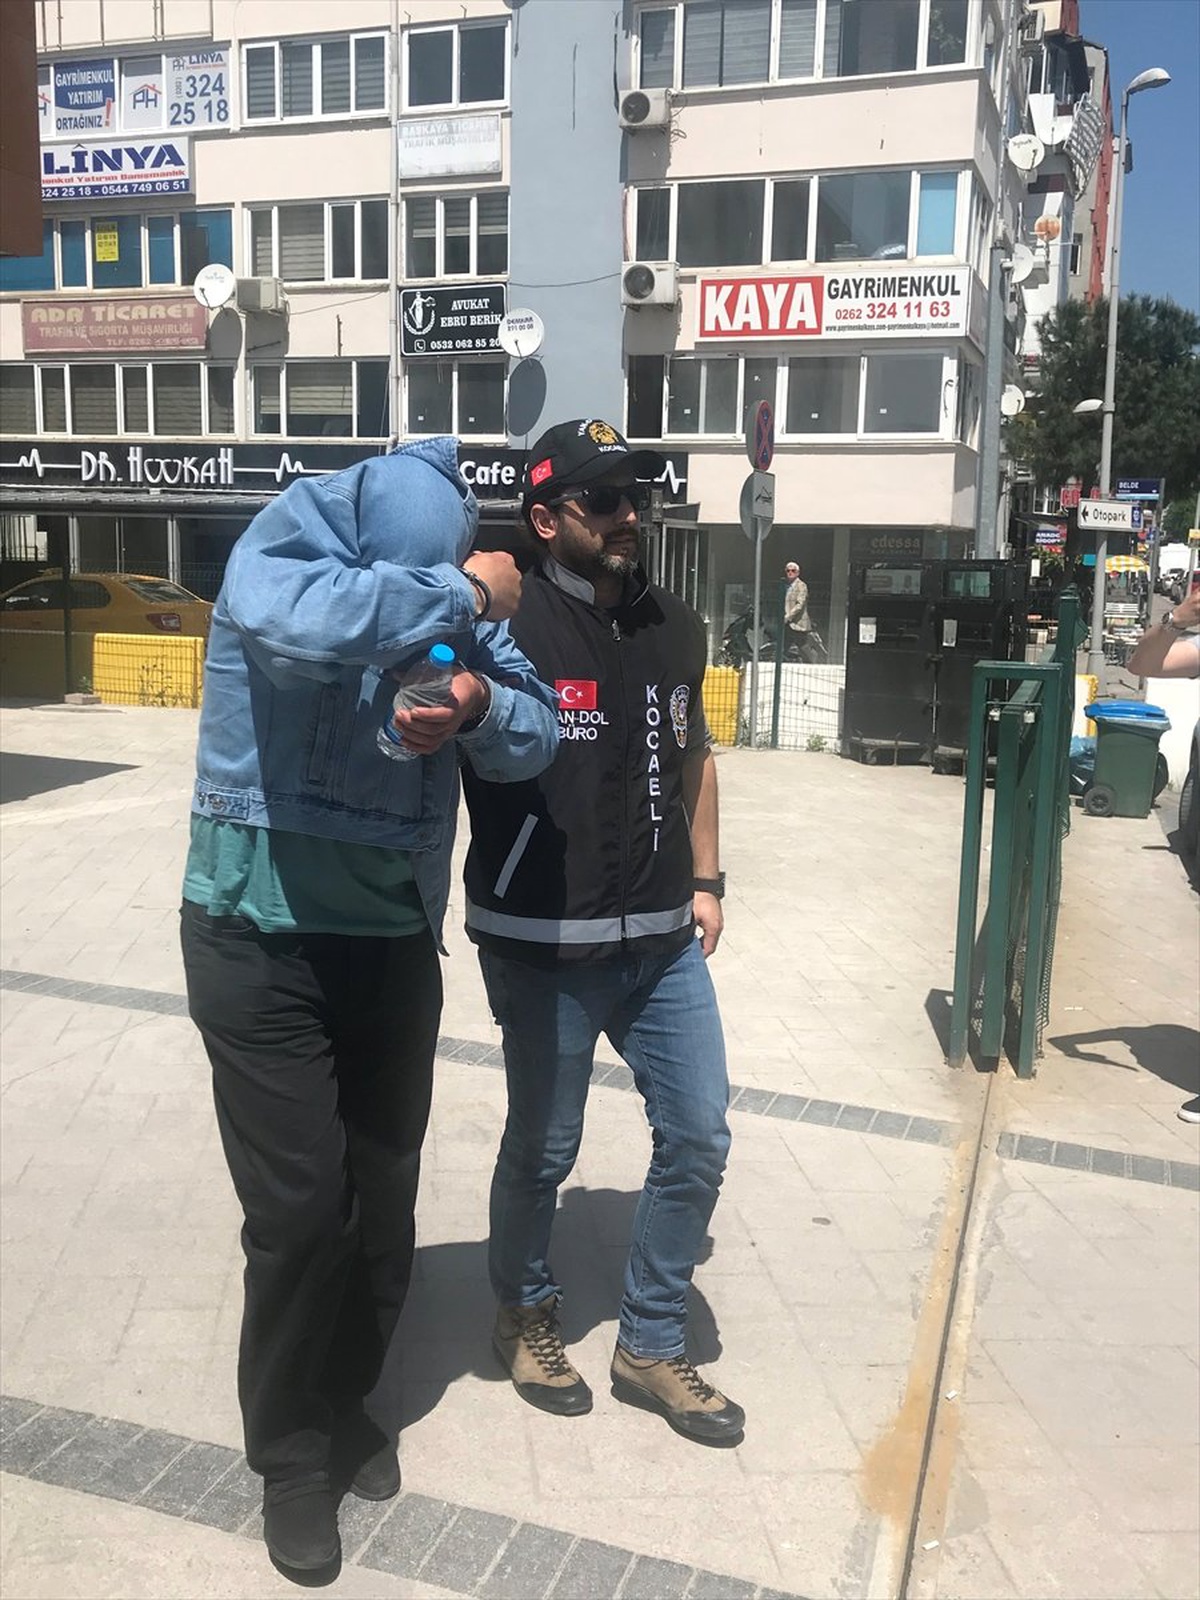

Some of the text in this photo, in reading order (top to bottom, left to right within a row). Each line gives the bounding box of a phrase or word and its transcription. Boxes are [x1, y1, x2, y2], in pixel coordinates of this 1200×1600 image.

[55, 69, 115, 87] GAYRİMENKUL
[186, 73, 224, 98] 324
[67, 90, 104, 105] YATIRIM
[170, 99, 228, 126] 25 18
[56, 113, 103, 130] ORTAĞINIZ
[61, 187, 75, 197] 25
[79, 186, 92, 196] 18
[101, 185, 128, 195] 0544
[131, 183, 152, 193] 749
[155, 182, 169, 191] 06
[173, 180, 186, 190] 51
[91, 302, 198, 322] TİCARET
[451, 298, 490, 311] AVUKAT
[704, 282, 818, 331] KAYA
[835, 301, 951, 320] 0262 324 11 63
[440, 315, 467, 328] EBRU
[430, 337, 501, 349] 0532 062 85 20
[81, 450, 123, 482] DR.
[459, 460, 516, 485] Cafe
[1093, 508, 1127, 524] Otopark
[557, 710, 609, 725] AN-DOL
[559, 723, 598, 740] BÜRO
